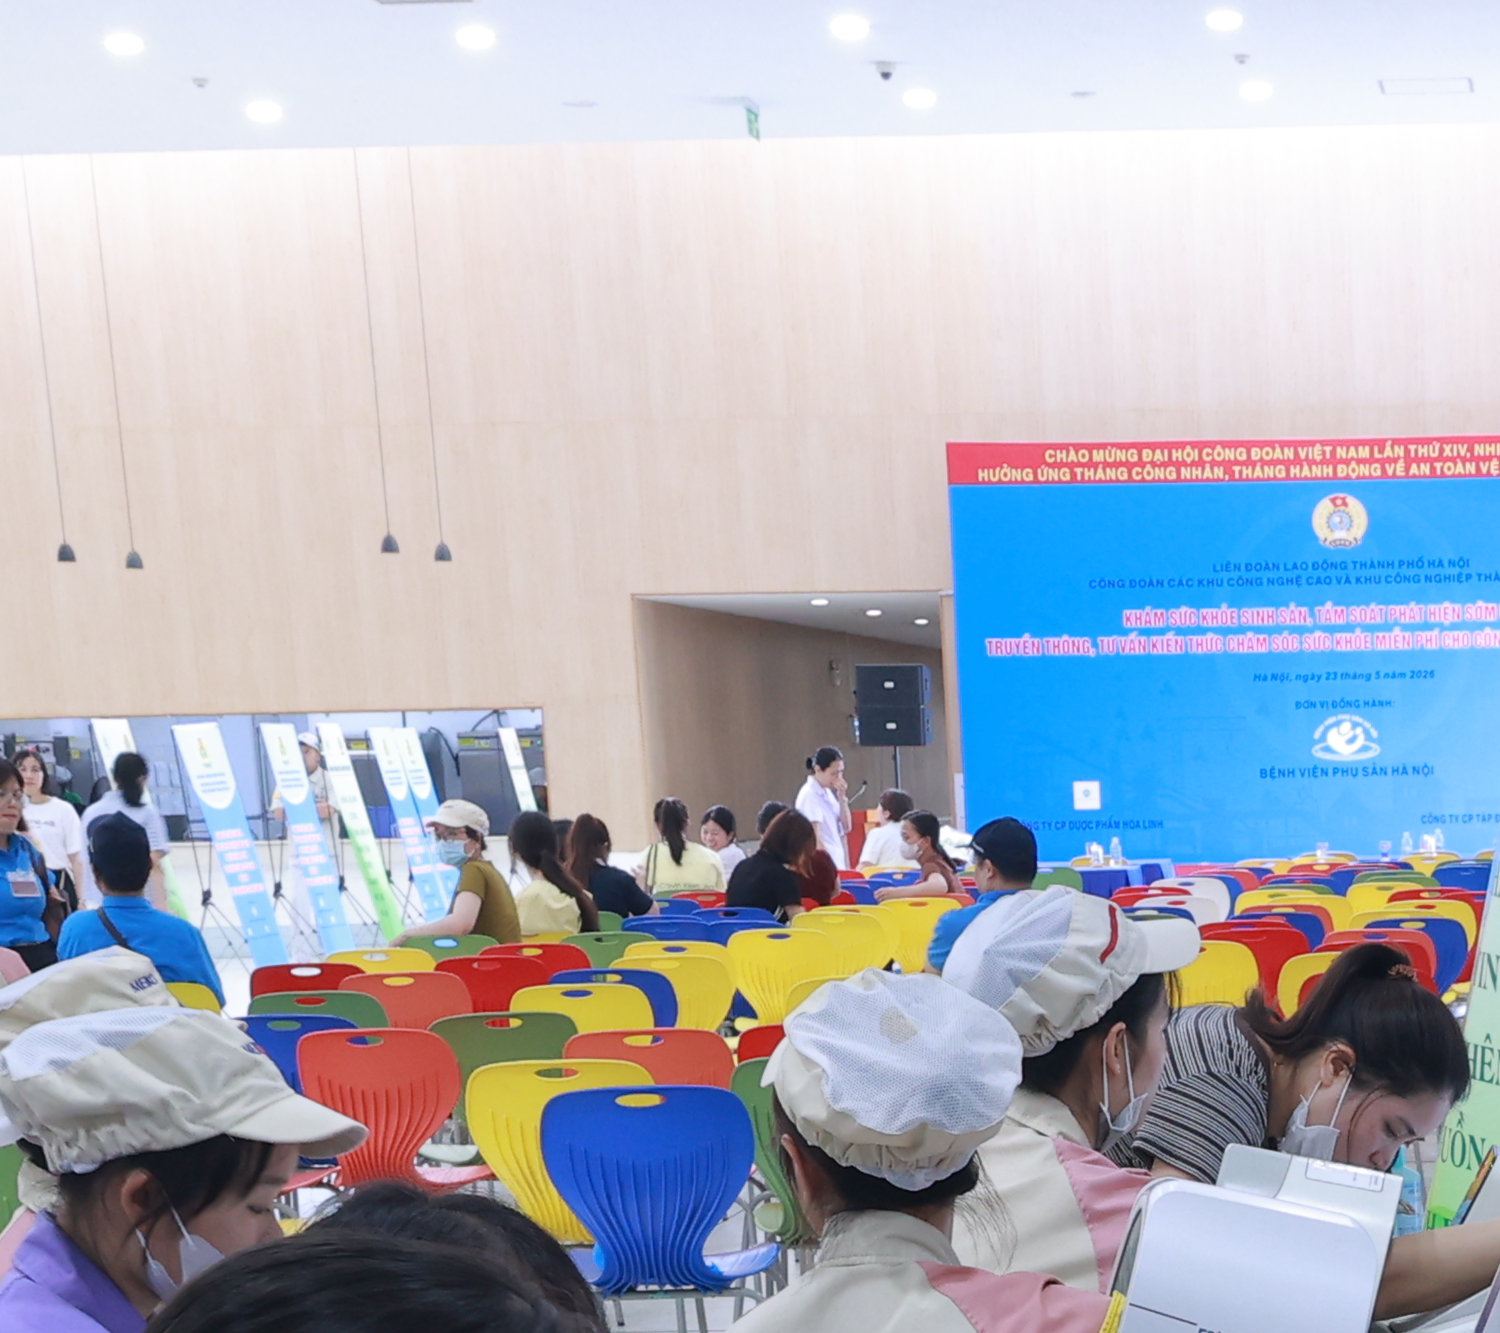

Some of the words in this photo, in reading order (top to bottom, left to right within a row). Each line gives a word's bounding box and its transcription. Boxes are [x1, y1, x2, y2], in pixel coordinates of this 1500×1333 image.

[1044, 446, 1090, 463] CHÀO
[1092, 445, 1139, 463] MỪNG
[1142, 448, 1169, 464] ĐẠI
[1171, 445, 1199, 464] HỘI
[1202, 446, 1247, 462] CÔNG
[1251, 444, 1294, 461] ĐOÀN
[1296, 443, 1332, 461] VIỆT
[1336, 446, 1370, 460] NAM
[1373, 442, 1405, 459] LẦN
[1407, 440, 1441, 458] THỨ
[1443, 443, 1472, 458] XIV,
[977, 465, 1034, 482] HƯỞNG
[1037, 464, 1072, 482] ỨNG
[1074, 464, 1129, 481] THÁNG
[1131, 464, 1177, 481] CÔNG
[1180, 463, 1230, 482] NHÂN,
[1232, 462, 1287, 480] THÁNG
[1290, 460, 1335, 479] HÀNH
[1337, 459, 1381, 479] ĐỘNG
[1385, 457, 1405, 477] VỀ
[1408, 461, 1431, 476] AN
[1433, 458, 1476, 475] TOÀN
[1479, 458, 1500, 476] VỆ
[1212, 560, 1241, 573] LIÊN
[1245, 559, 1281, 572] ĐOÀN
[1283, 560, 1308, 572] LAO
[1311, 558, 1348, 573] ĐỘNG
[1351, 556, 1395, 571] THÀNH
[1397, 554, 1425, 569] PHỐ
[1427, 556, 1446, 569] HÀ
[1448, 556, 1470, 570] NỘI
[1088, 576, 1126, 589] CÔNG
[1129, 575, 1164, 589] ĐOÀN
[1167, 574, 1194, 588] CÁC
[1197, 576, 1224, 588] KHU
[1227, 574, 1264, 587] CÔNG
[1266, 574, 1303, 587] NGHỆ
[1305, 573, 1333, 586] CAO
[1335, 572, 1352, 585] VÀ
[1354, 573, 1381, 585] KHU
[1384, 571, 1421, 584] CÔNG
[1424, 571, 1473, 585] NGHIỆP
[1123, 605, 1166, 628] KHÁM
[1168, 604, 1198, 627] SỨC
[1201, 603, 1238, 626] KHỎE
[1241, 607, 1276, 626] SINH
[1316, 601, 1346, 624] TẦM
[1348, 602, 1385, 624] SOÁT
[1389, 602, 1425, 623] PHÁT
[1428, 601, 1461, 626] HIỆN
[1465, 601, 1497, 621] SỚM
[986, 633, 1041, 656] TRUYỀN
[1044, 634, 1096, 657] THÔNG,
[1118, 632, 1148, 655] VẤN
[1150, 631, 1184, 654] KIẾN
[1187, 633, 1224, 654] THỨC
[1227, 632, 1269, 653] CHĂM
[1272, 631, 1300, 652] SÓC
[1303, 629, 1332, 651] SỨC
[1335, 627, 1371, 650] KHỎE
[1375, 626, 1410, 650] MIỄN
[1415, 627, 1440, 649] PHÍ
[1442, 630, 1471, 648] CHO
[1252, 671, 1268, 683] Hà
[1324, 670, 1339, 682] 23
[1340, 670, 1373, 684] tháng
[1374, 670, 1382, 681] 5
[1383, 669, 1407, 681] năm
[1409, 669, 1436, 680] 2026
[1331, 695, 1361, 710] ĐỒNG
[1363, 696, 1396, 709] HÀNH:
[1259, 767, 1295, 781] BỆNH
[1297, 765, 1330, 780] VIỆN
[1332, 765, 1358, 779] PHỤ
[1363, 762, 1387, 778] SẢN
[1391, 762, 1408, 776] HÀ
[1411, 764, 1435, 777] NỘI
